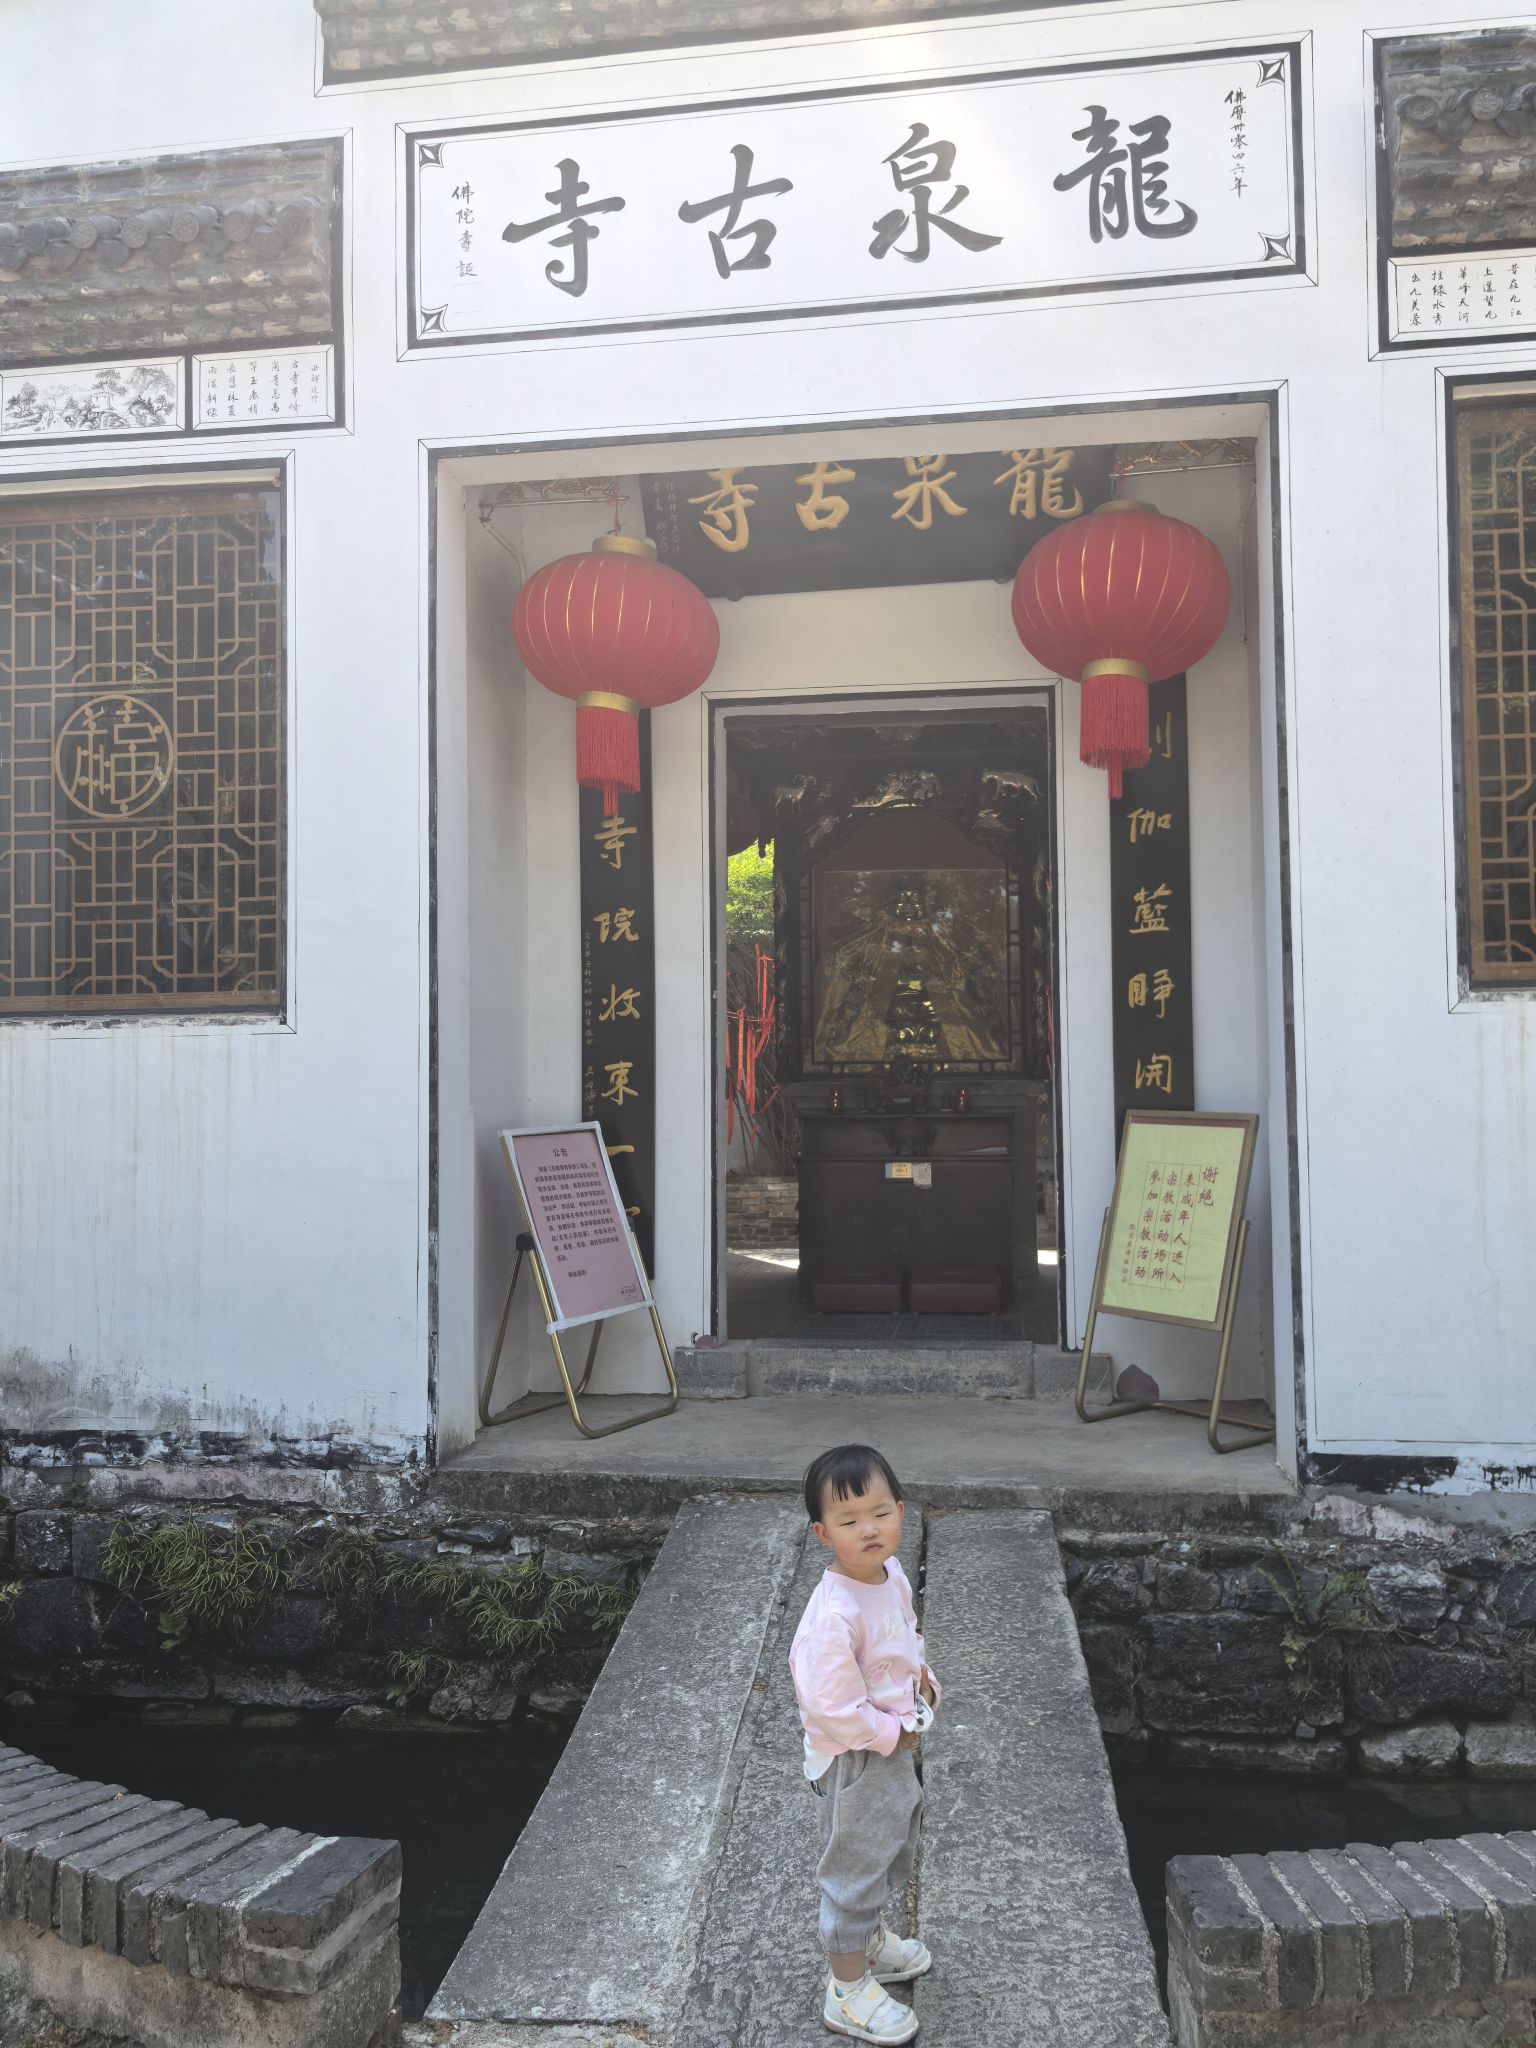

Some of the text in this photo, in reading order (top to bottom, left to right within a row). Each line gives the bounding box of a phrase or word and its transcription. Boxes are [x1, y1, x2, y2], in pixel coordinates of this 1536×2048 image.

[502, 104, 1198, 298] 龍泉古寺
[1151, 1169, 1178, 1283] 宗教活动场所
[1197, 1166, 1219, 1206] 谢绝
